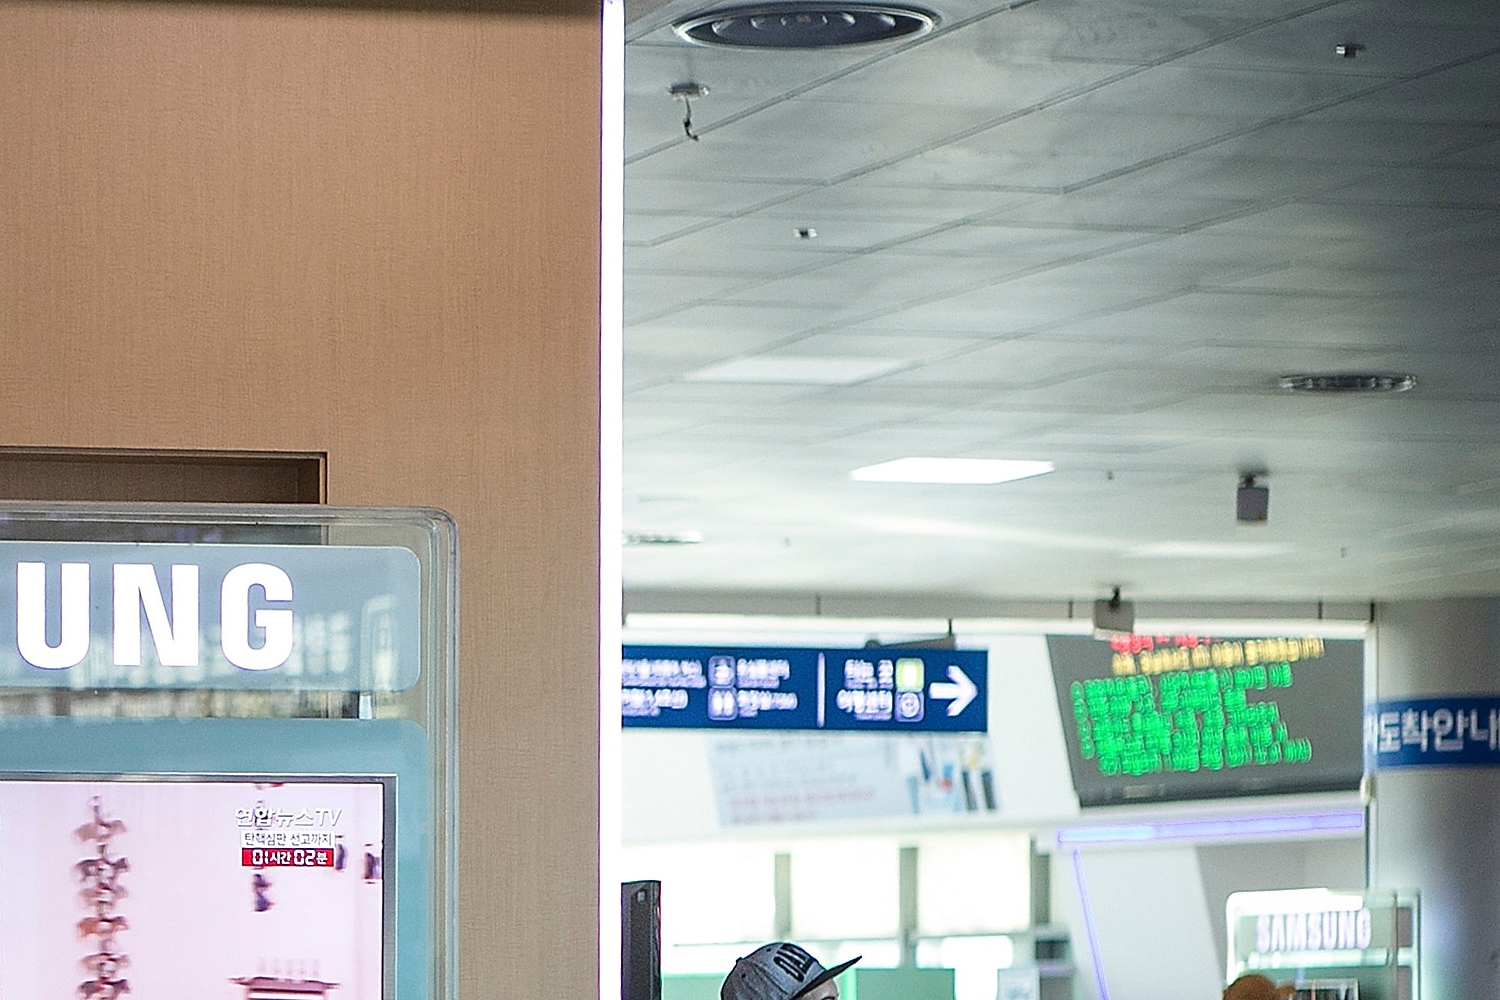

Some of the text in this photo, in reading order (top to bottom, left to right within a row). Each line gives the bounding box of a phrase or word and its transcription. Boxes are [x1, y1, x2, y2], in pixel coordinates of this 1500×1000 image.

[235, 808, 342, 828] 연합뉴스TV
[244, 832, 332, 846] 탄핵심판 선고까지
[252, 850, 328, 865] 01시간 02분
[1256, 908, 1371, 953] SAMSUNG
